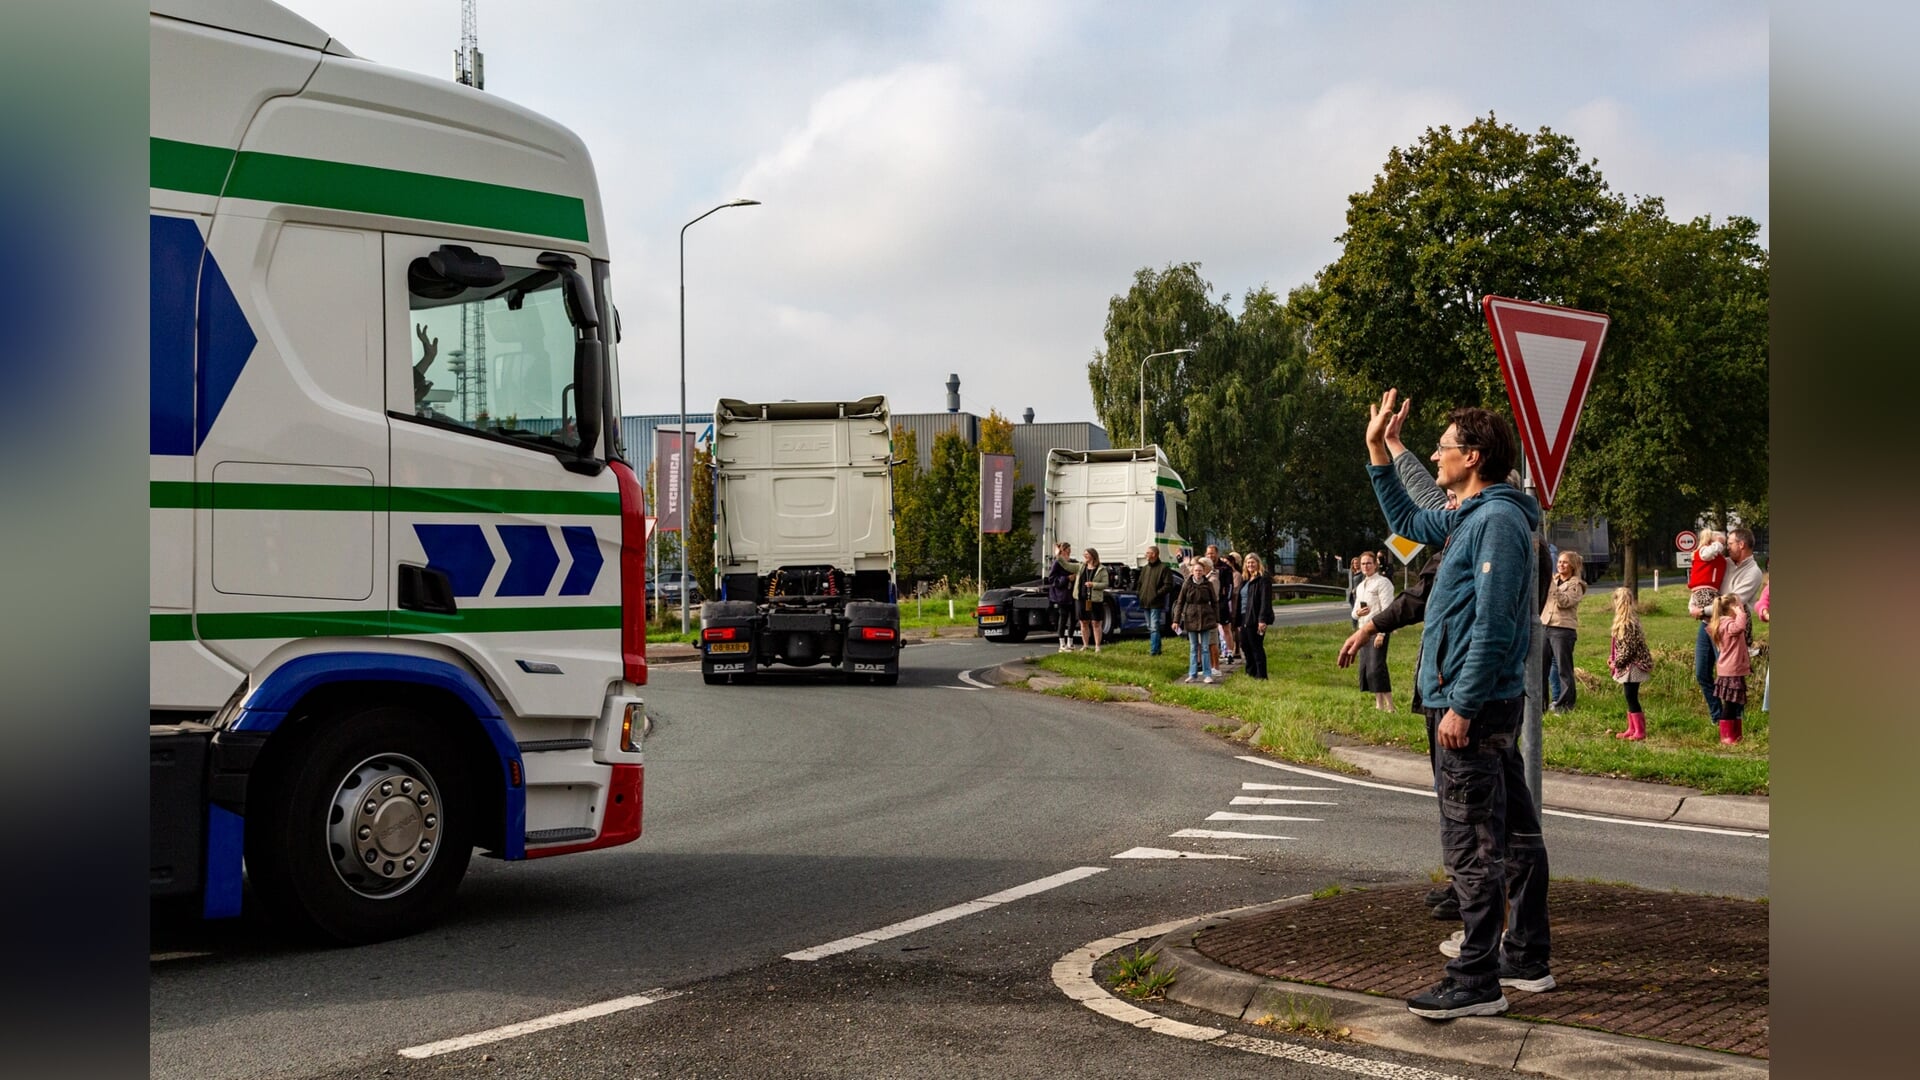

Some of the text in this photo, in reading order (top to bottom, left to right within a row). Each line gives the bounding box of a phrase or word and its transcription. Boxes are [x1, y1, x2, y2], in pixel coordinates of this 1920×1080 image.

[778, 441, 830, 452] DAF
[669, 452, 680, 514] TECHNICA
[994, 471, 1003, 519] TECHNICA
[713, 663, 745, 671] DAF
[855, 663, 885, 671] DAF
